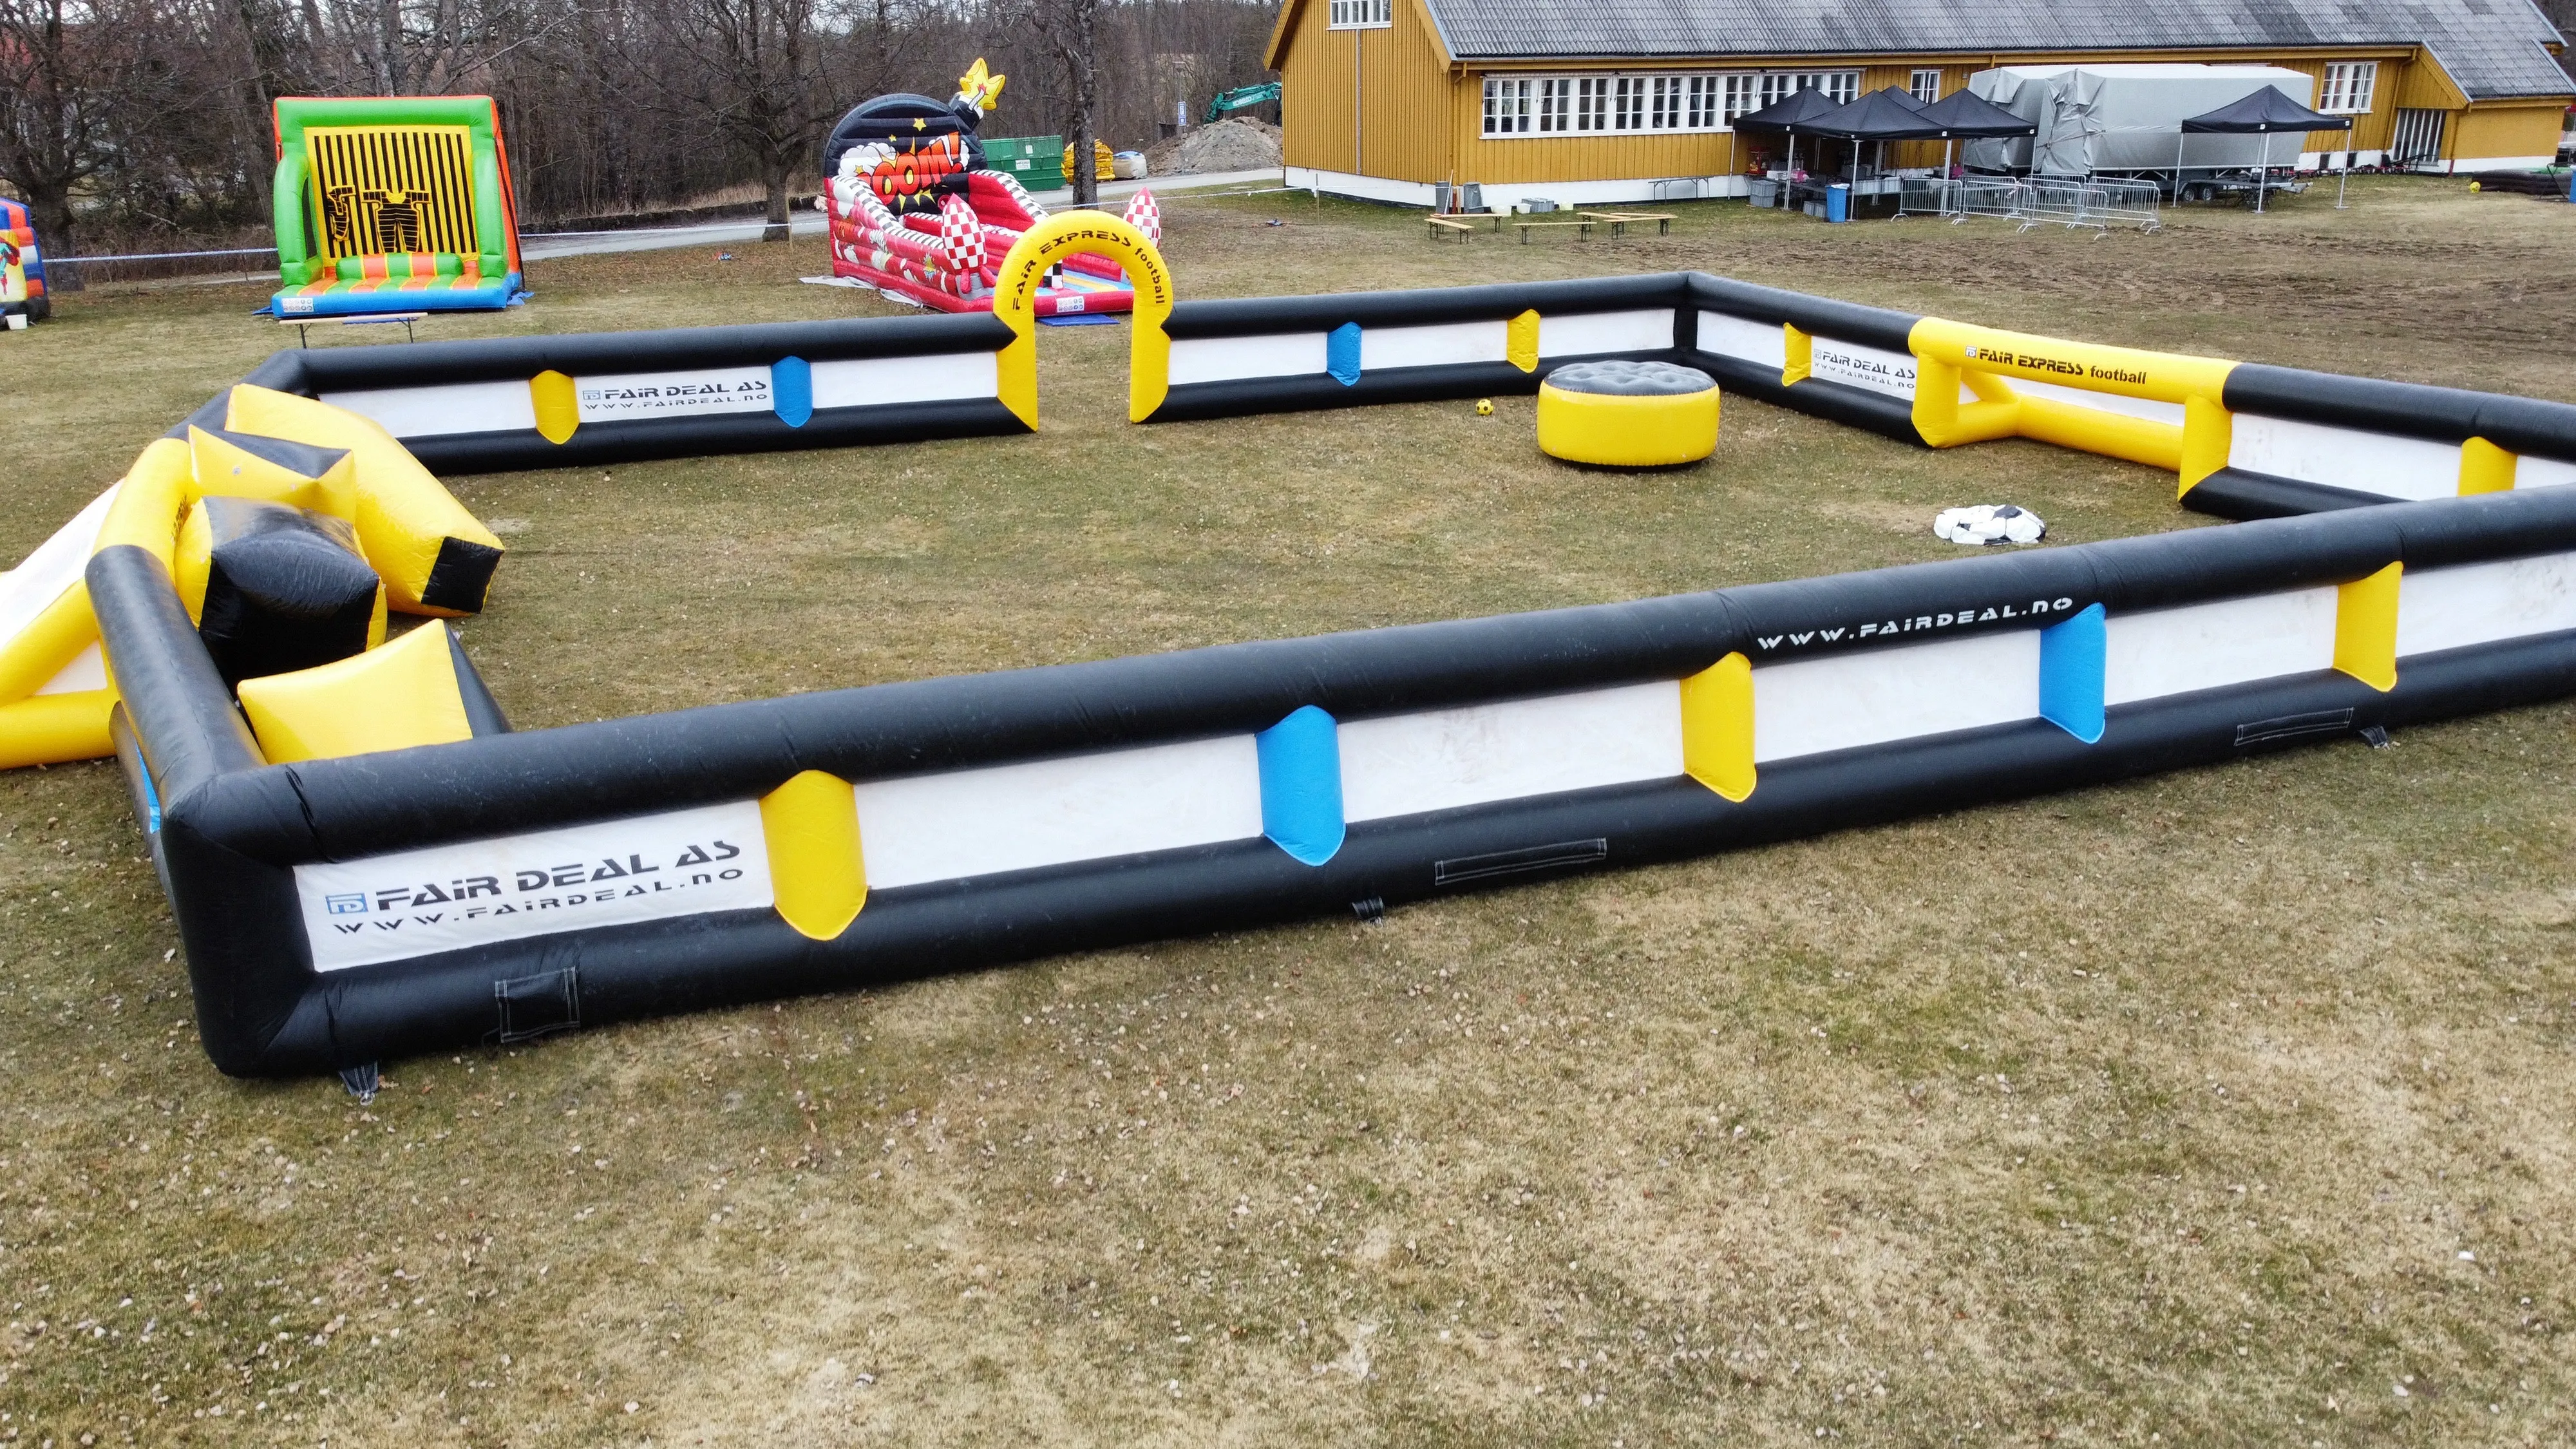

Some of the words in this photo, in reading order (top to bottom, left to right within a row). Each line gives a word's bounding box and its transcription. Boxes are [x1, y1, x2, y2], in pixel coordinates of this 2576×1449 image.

[857, 131, 962, 205] OOM!
[1039, 230, 1132, 255] EXPRESS
[1135, 247, 1165, 305] football
[666, 383, 730, 396] DEAL
[737, 381, 767, 392] AS
[1853, 359, 1890, 375] DEAL
[1895, 368, 1915, 379] AS
[2018, 355, 2084, 375] EXPRESS
[2090, 365, 2146, 384] football
[516, 854, 659, 893] DEAL
[675, 840, 741, 868] AS
